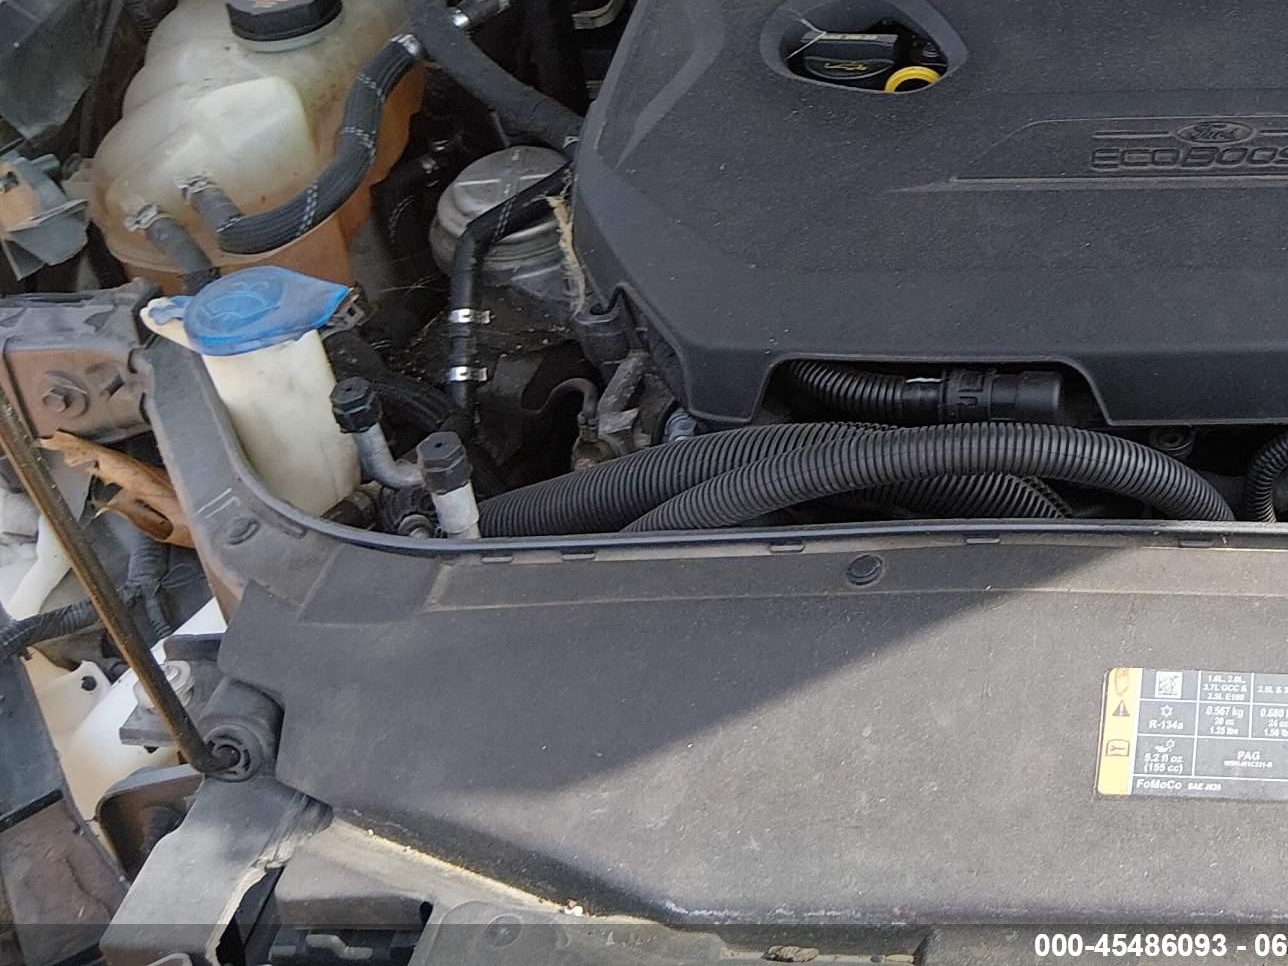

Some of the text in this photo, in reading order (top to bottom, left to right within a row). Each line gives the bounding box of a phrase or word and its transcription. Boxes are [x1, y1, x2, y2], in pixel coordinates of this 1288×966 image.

[1205, 705, 1244, 719] 0.567 kg
[1149, 719, 1184, 730] R-134a
[1226, 726, 1239, 735] lbs
[1170, 755, 1184, 763] oz
[1237, 750, 1261, 761] PAG
[1167, 763, 1184, 775] cc)
[1136, 778, 1183, 790] FoMoCo
